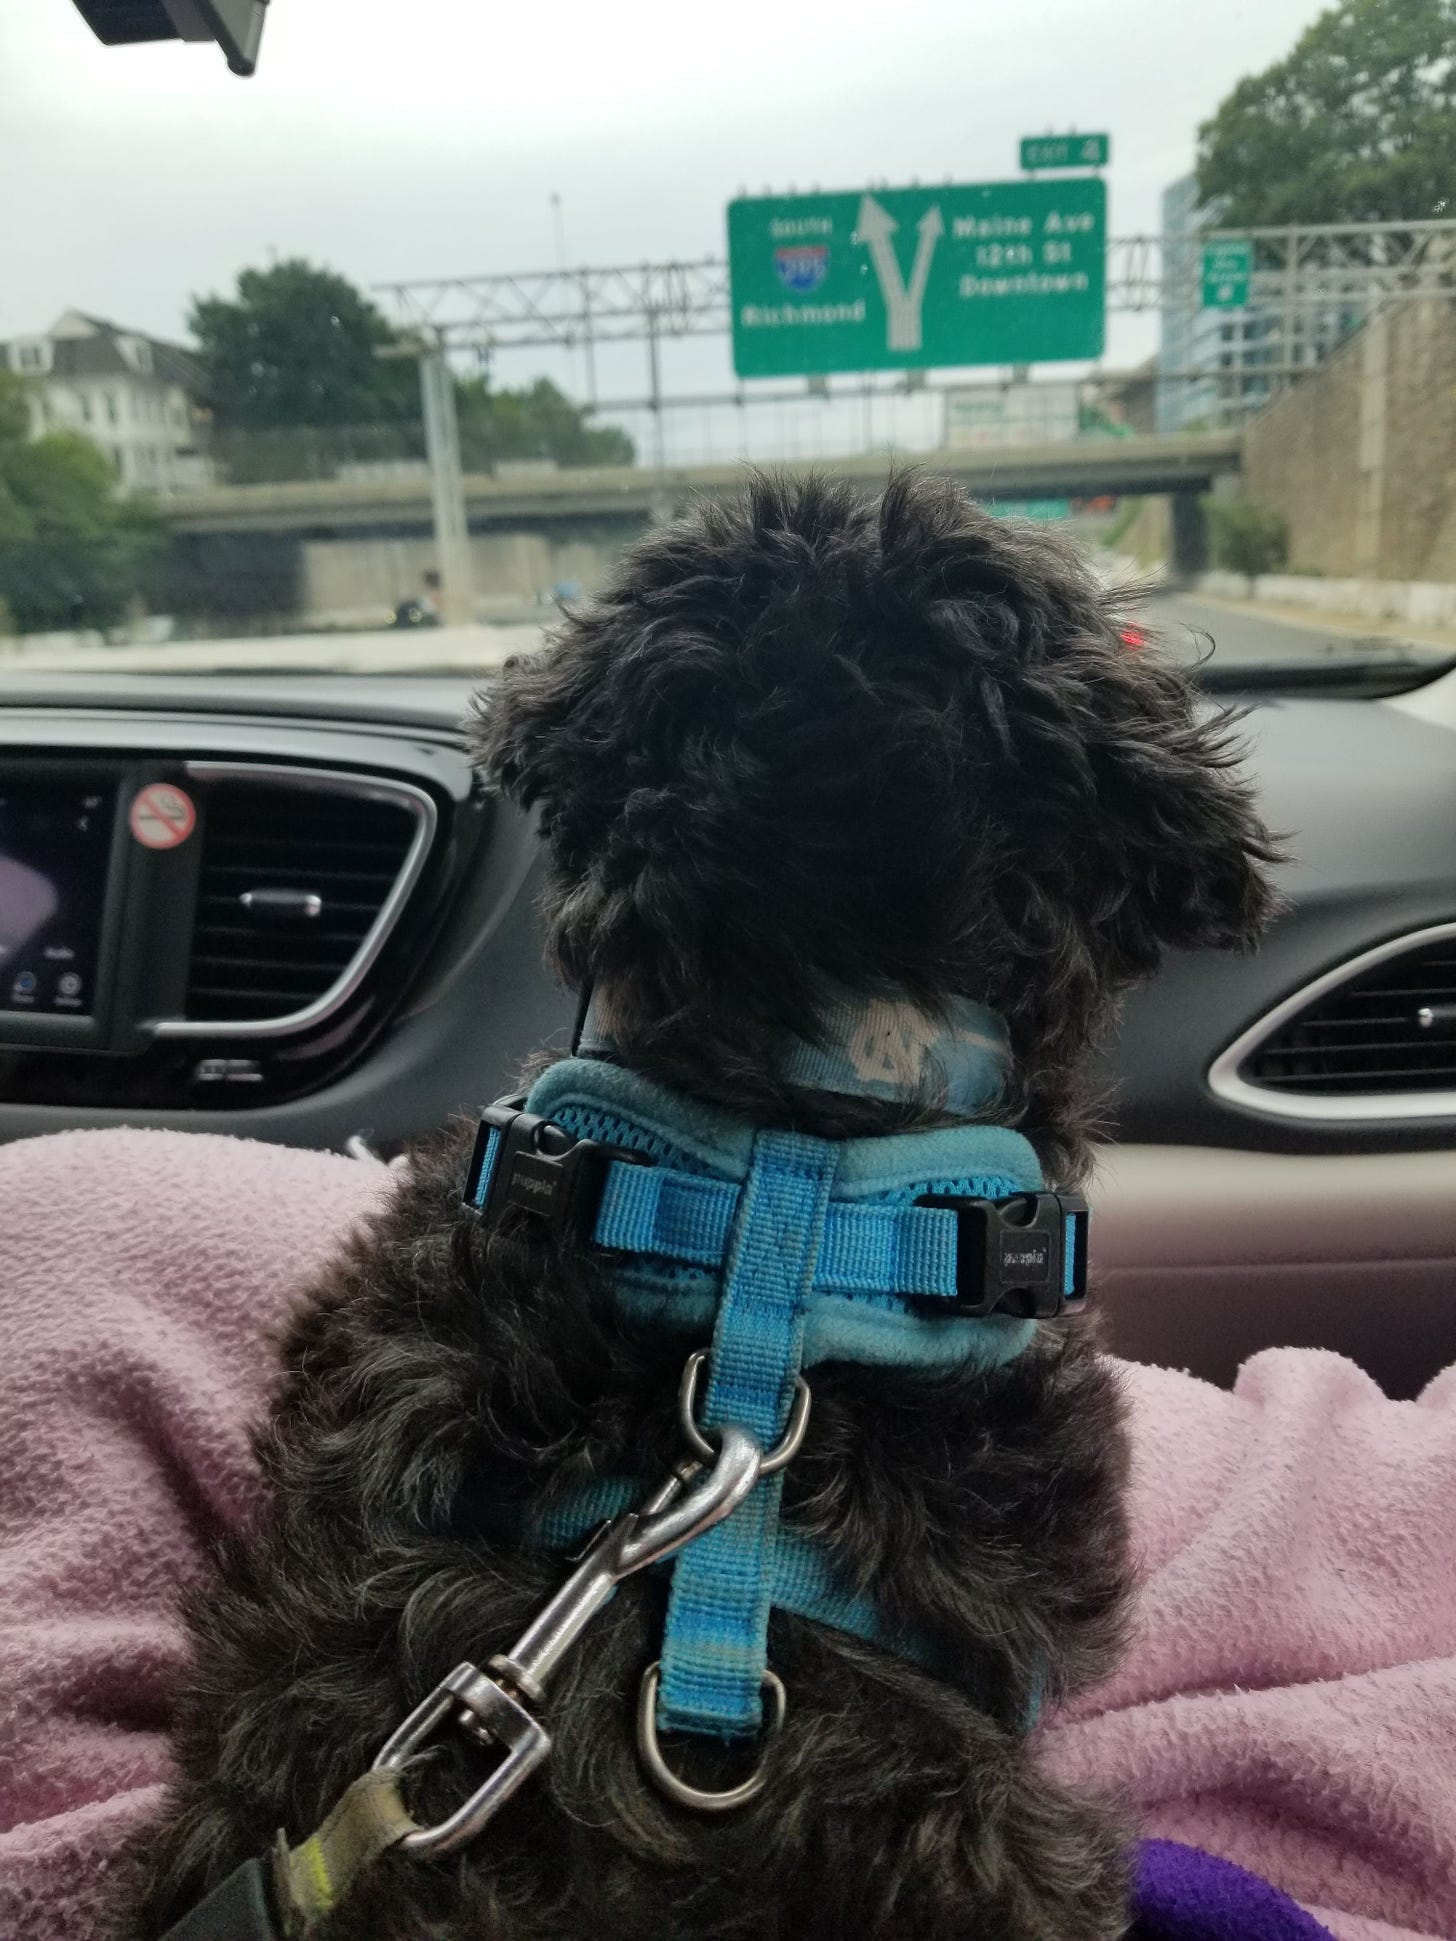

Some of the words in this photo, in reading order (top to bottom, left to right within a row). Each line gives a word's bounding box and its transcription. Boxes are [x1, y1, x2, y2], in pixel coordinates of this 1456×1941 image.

[953, 215, 1032, 238] Maine
[1043, 212, 1095, 233] Ave
[976, 244, 1033, 267] 12th
[1043, 241, 1072, 264] St
[960, 273, 1089, 298] Downtown
[741, 299, 866, 328] Richmond
